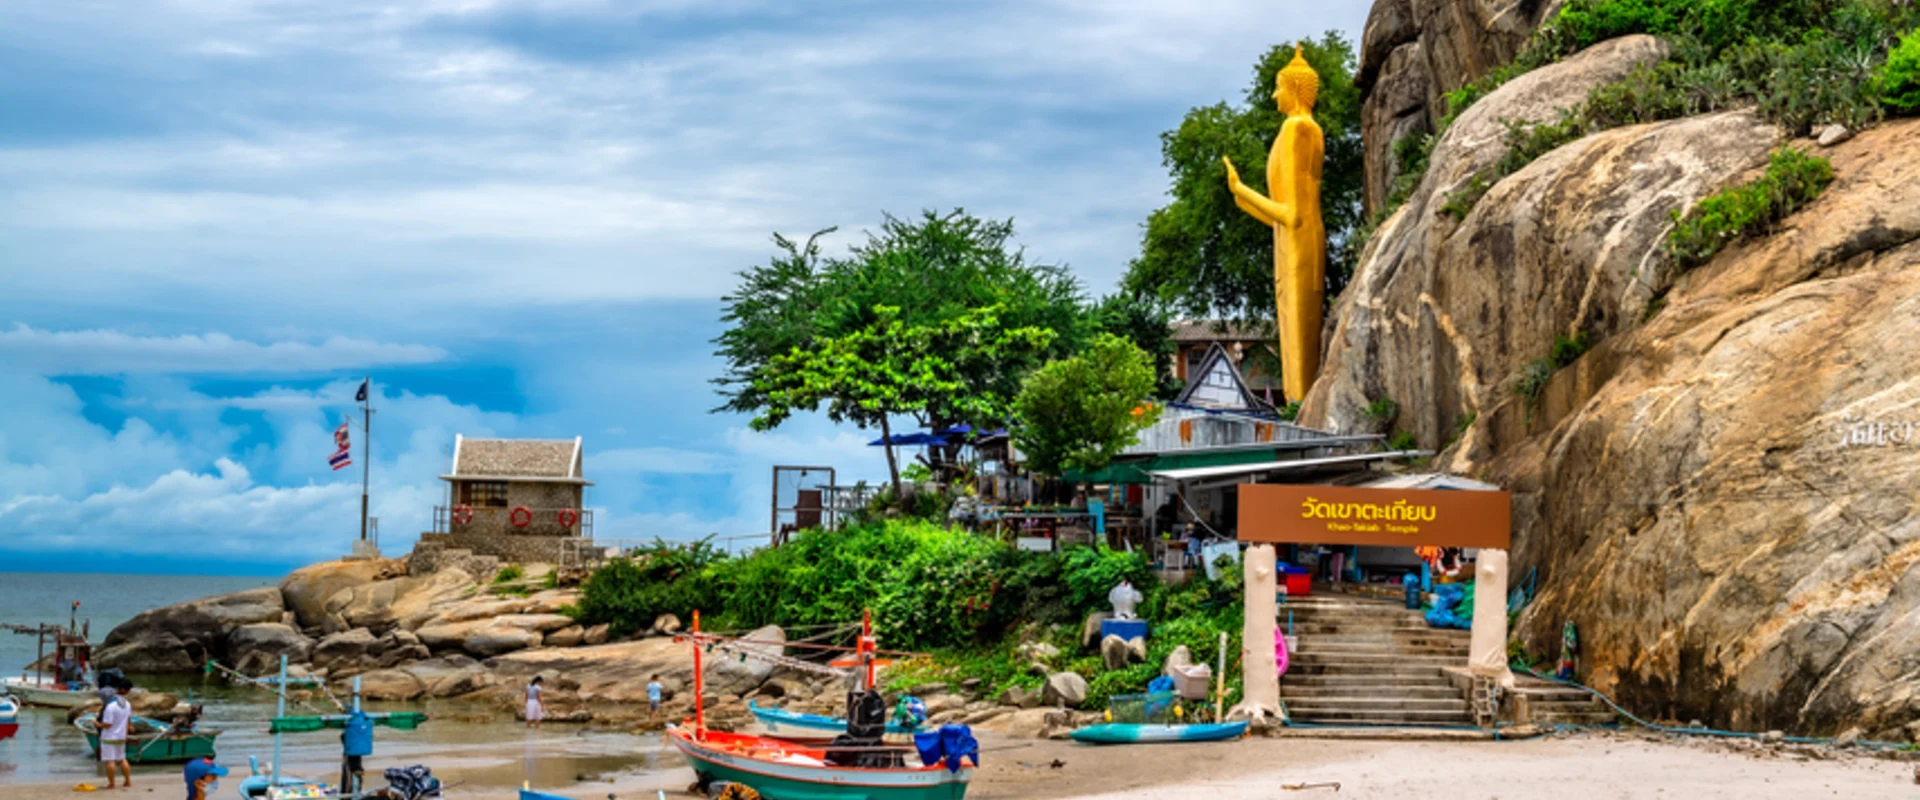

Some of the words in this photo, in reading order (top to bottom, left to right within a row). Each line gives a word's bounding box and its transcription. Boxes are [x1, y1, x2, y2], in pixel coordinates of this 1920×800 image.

[1302, 497, 1436, 521] วัดเขาตะเกียบ
[1385, 523, 1419, 534] Temple
